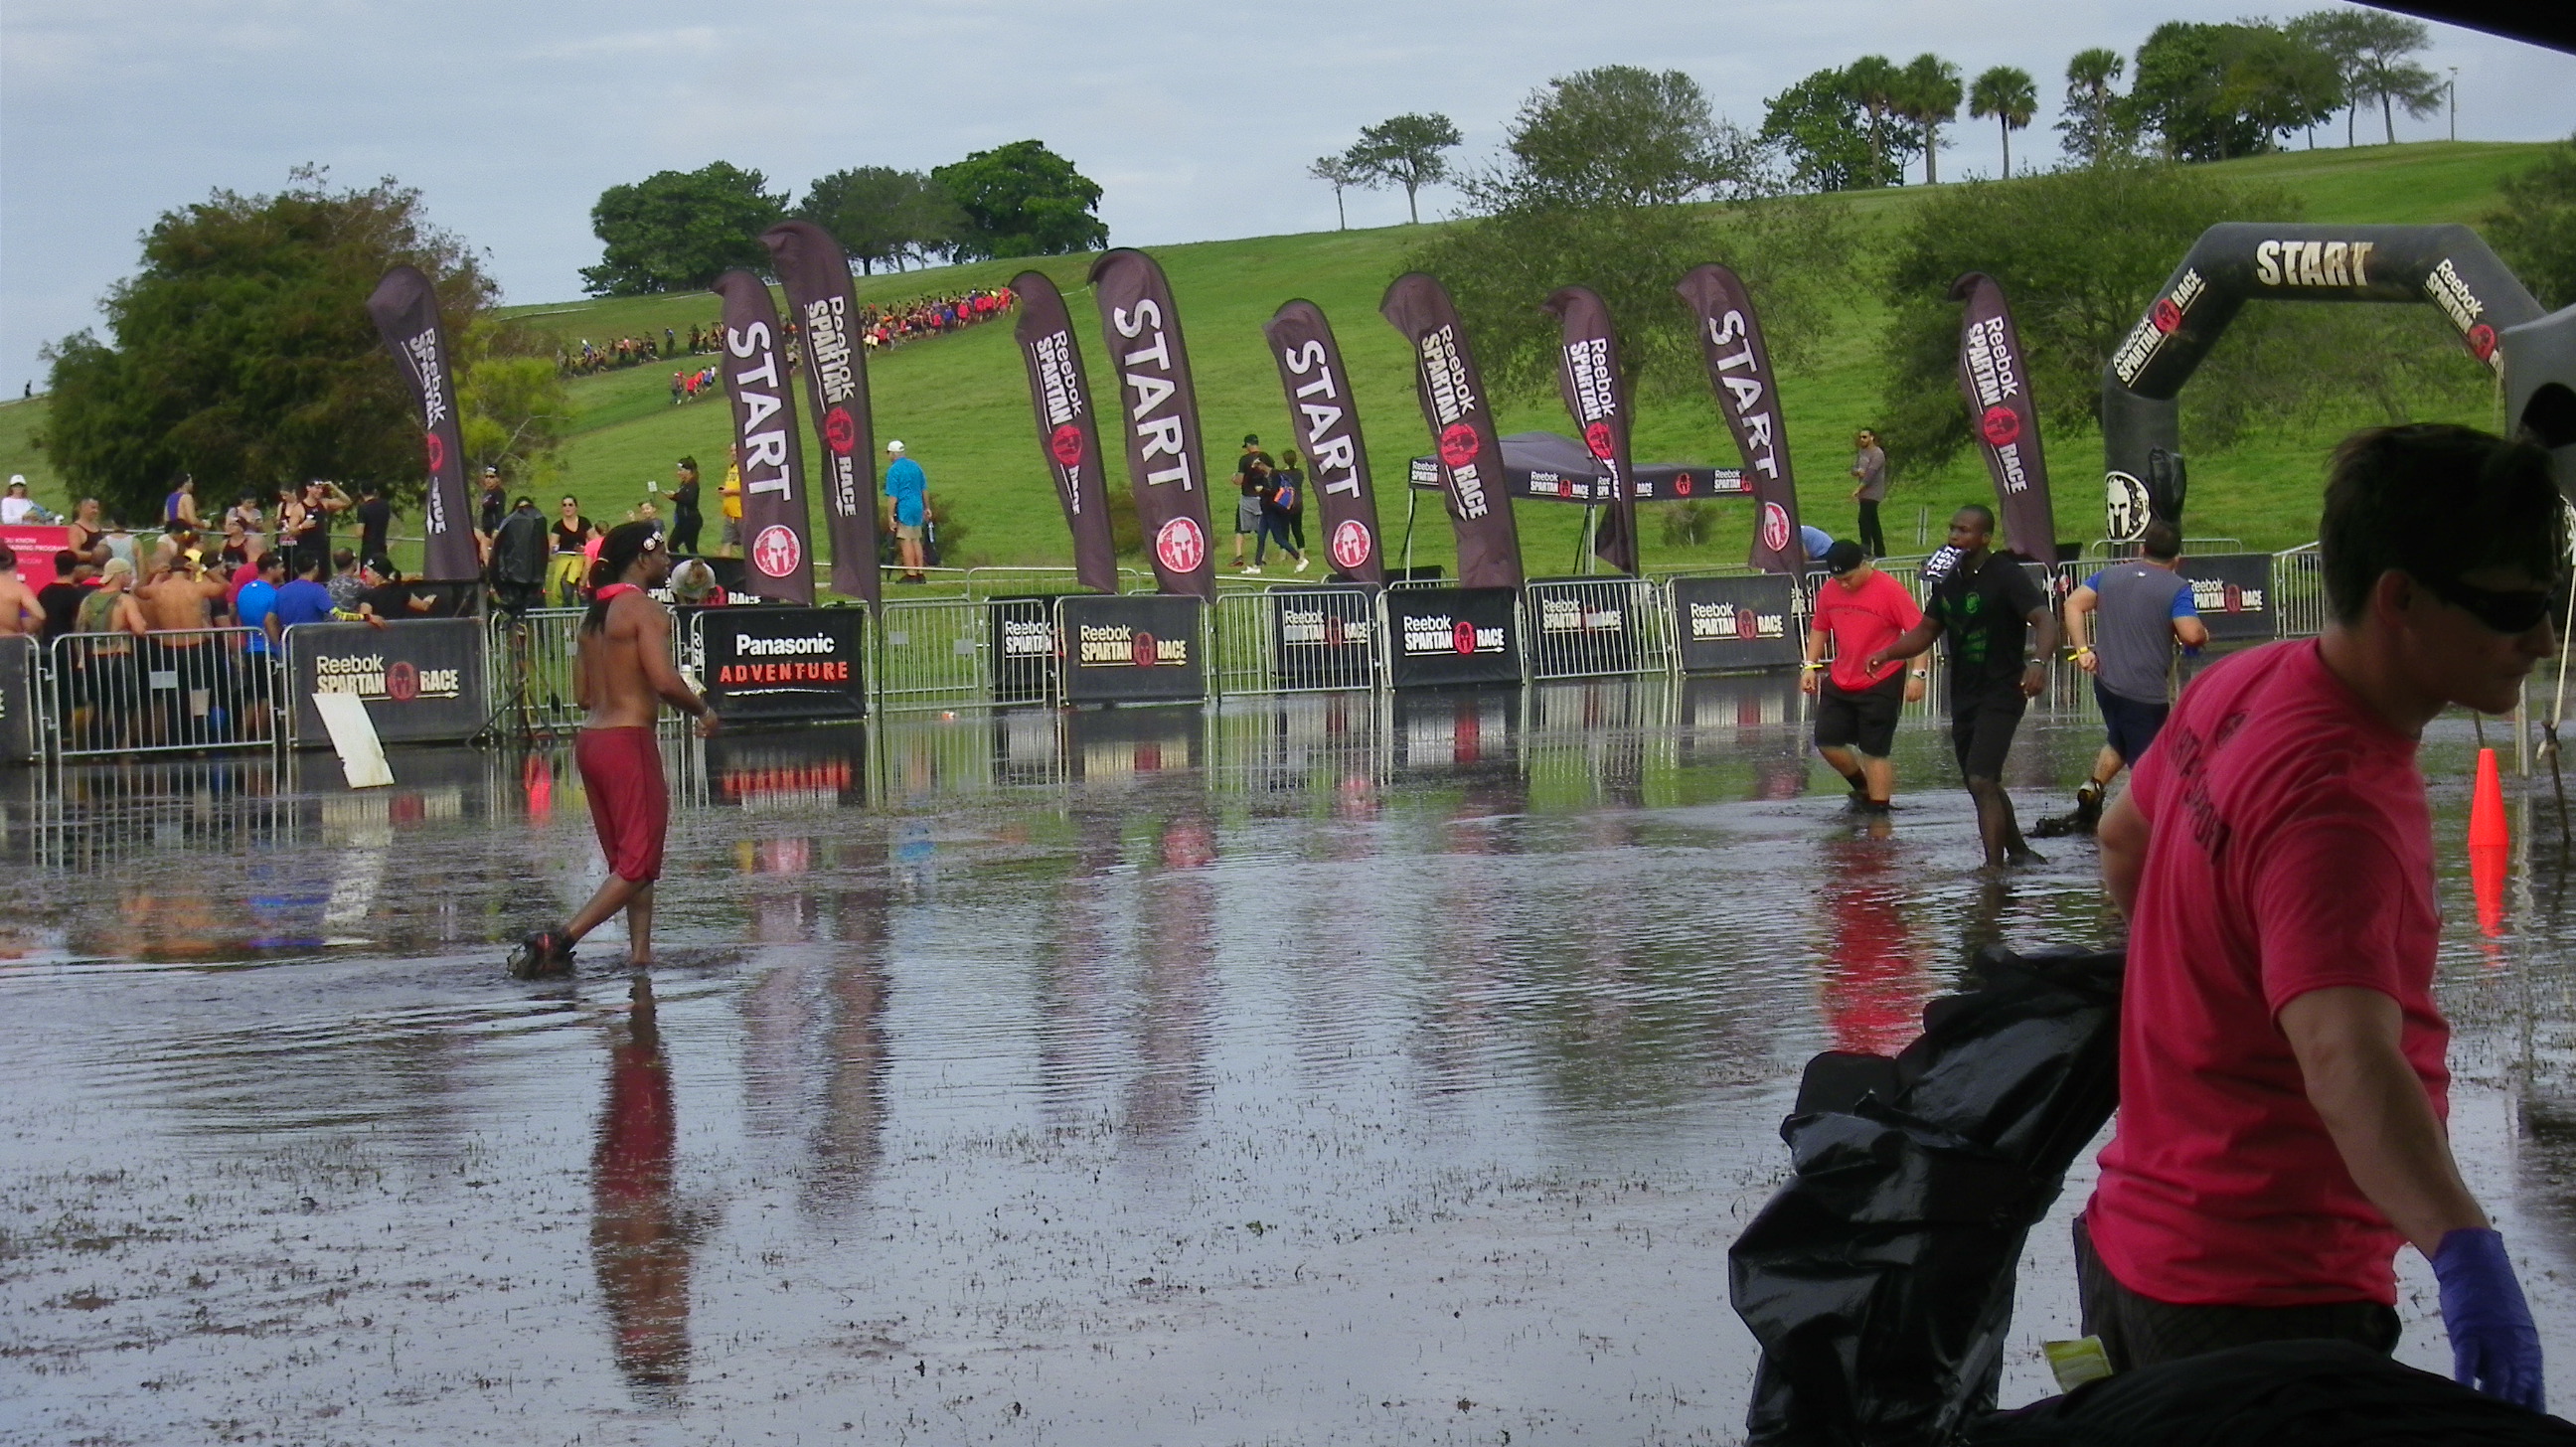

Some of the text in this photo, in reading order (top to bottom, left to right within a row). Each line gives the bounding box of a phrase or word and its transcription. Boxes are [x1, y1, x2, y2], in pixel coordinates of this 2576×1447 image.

[2256, 240, 2374, 286] START
[2436, 256, 2484, 319] Reebok
[2425, 271, 2474, 334] SPARTAN
[2117, 266, 2202, 383] SPARTAN RACE
[2113, 313, 2152, 369] Reebok
[1439, 324, 1476, 414] Reebok
[1986, 316, 2019, 400] Reebok
[424, 327, 447, 423] Reebok
[1037, 336, 1074, 425] SPARTAN
[1052, 330, 1082, 417] Reebok
[1571, 341, 1602, 421] SPARTAN
[1590, 337, 1615, 417] Reebok
[808, 300, 857, 517] SPARTAN RACE
[1113, 298, 1193, 492] START
[1708, 309, 1780, 480] START
[1968, 322, 2028, 495] SPARTAN RACE
[727, 321, 792, 502] START
[1286, 339, 1362, 499] START
[1421, 332, 1488, 520] SPARTAN RACE
[1411, 470, 1438, 482] SPARTAN
[1412, 461, 1439, 472] Reebok
[1530, 471, 1558, 483] Reebok
[1714, 470, 1740, 479] Reebok
[1530, 480, 1559, 494] SPARTAN
[1572, 483, 1589, 496] RACE
[1597, 476, 1611, 486] Ree
[1714, 478, 1740, 489] SPARTAN
[1927, 546, 1955, 577] 13457
[1690, 601, 1735, 618] Reebok
[2194, 590, 2263, 609] PARTAN RACE
[1285, 609, 1324, 625] Reebok
[1403, 614, 1453, 632] Reebok
[1691, 614, 1784, 636] SPARTAN RACE
[735, 631, 836, 656] Panasonic
[1080, 624, 1132, 642] Reebok
[1285, 624, 1326, 641] RTAN
[1404, 628, 1505, 651] SPARTAN RACE
[316, 653, 385, 675] Reebok
[1080, 640, 1187, 662] SPARTAN RACE
[317, 669, 459, 694] SPARTAN RACE
[720, 661, 848, 683] ADVENTURE
